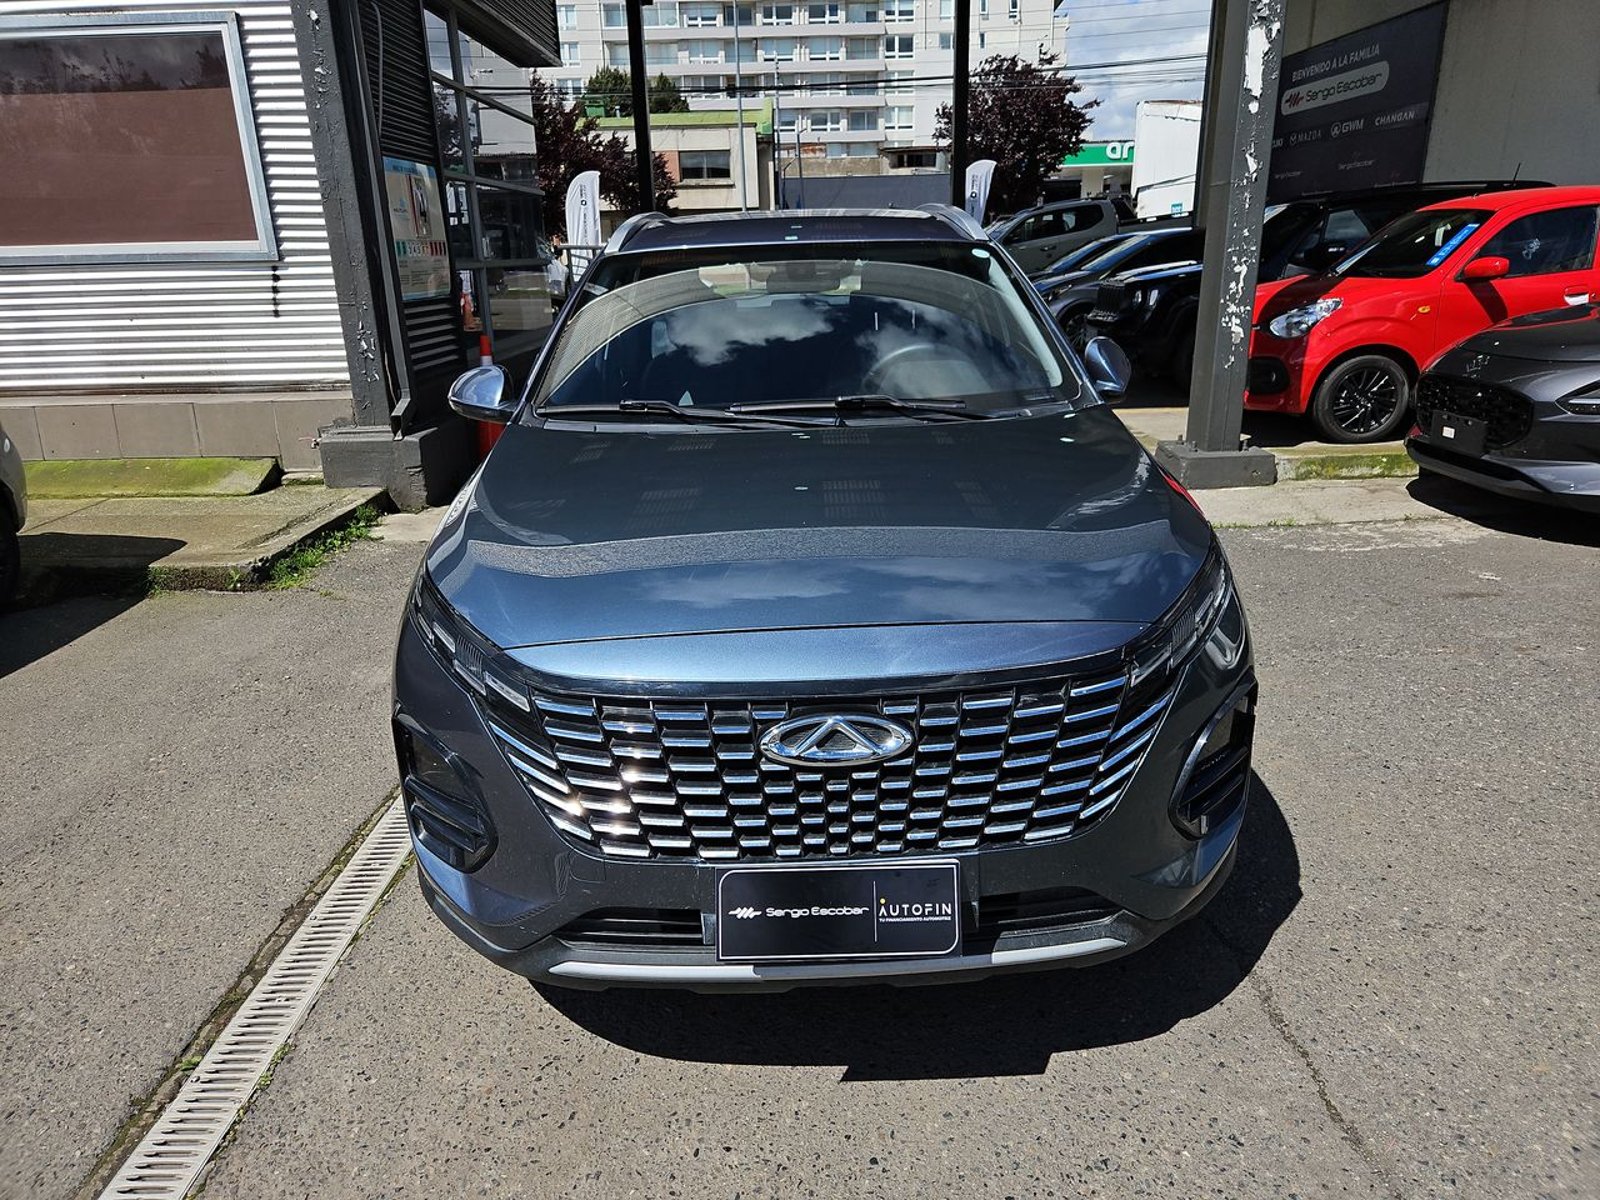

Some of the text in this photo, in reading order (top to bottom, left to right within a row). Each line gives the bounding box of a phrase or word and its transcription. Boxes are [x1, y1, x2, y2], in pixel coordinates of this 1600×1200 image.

[1291, 43, 1380, 82] BIENVENIDO A LA FAMILIA
[1374, 110, 1416, 126] CHANGAN
[1341, 119, 1365, 134] GWM
[810, 905, 870, 916] Escobar
[879, 899, 952, 917] AUTOFIN
